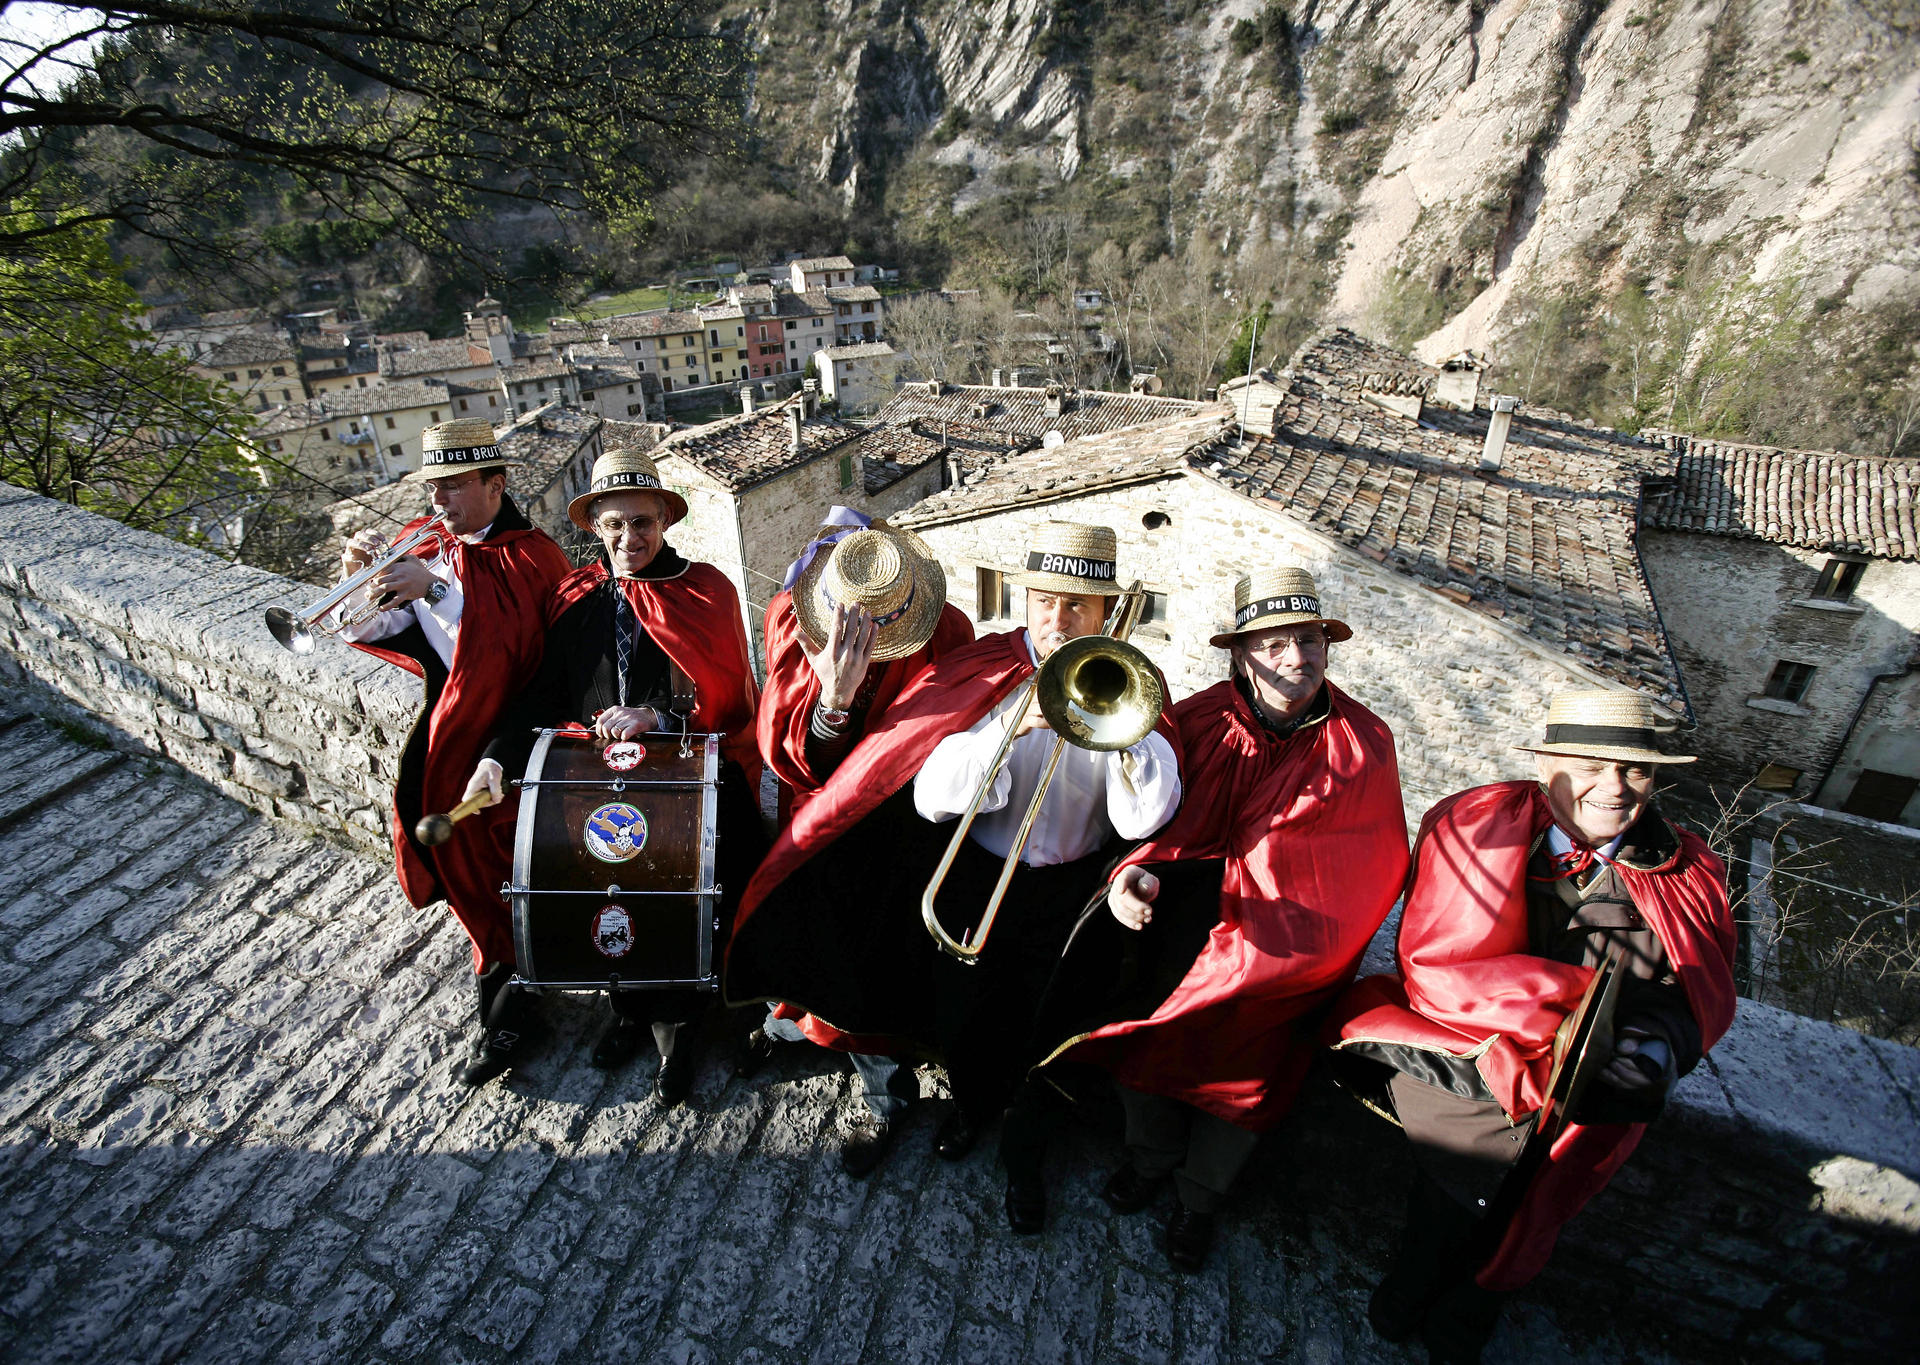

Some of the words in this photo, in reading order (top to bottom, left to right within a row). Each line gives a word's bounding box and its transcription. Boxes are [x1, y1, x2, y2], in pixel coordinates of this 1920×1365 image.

[448, 451, 467, 461] DEI
[612, 474, 630, 485] DEI
[1041, 553, 1110, 578] BANDINO
[1267, 599, 1286, 611] DEI
